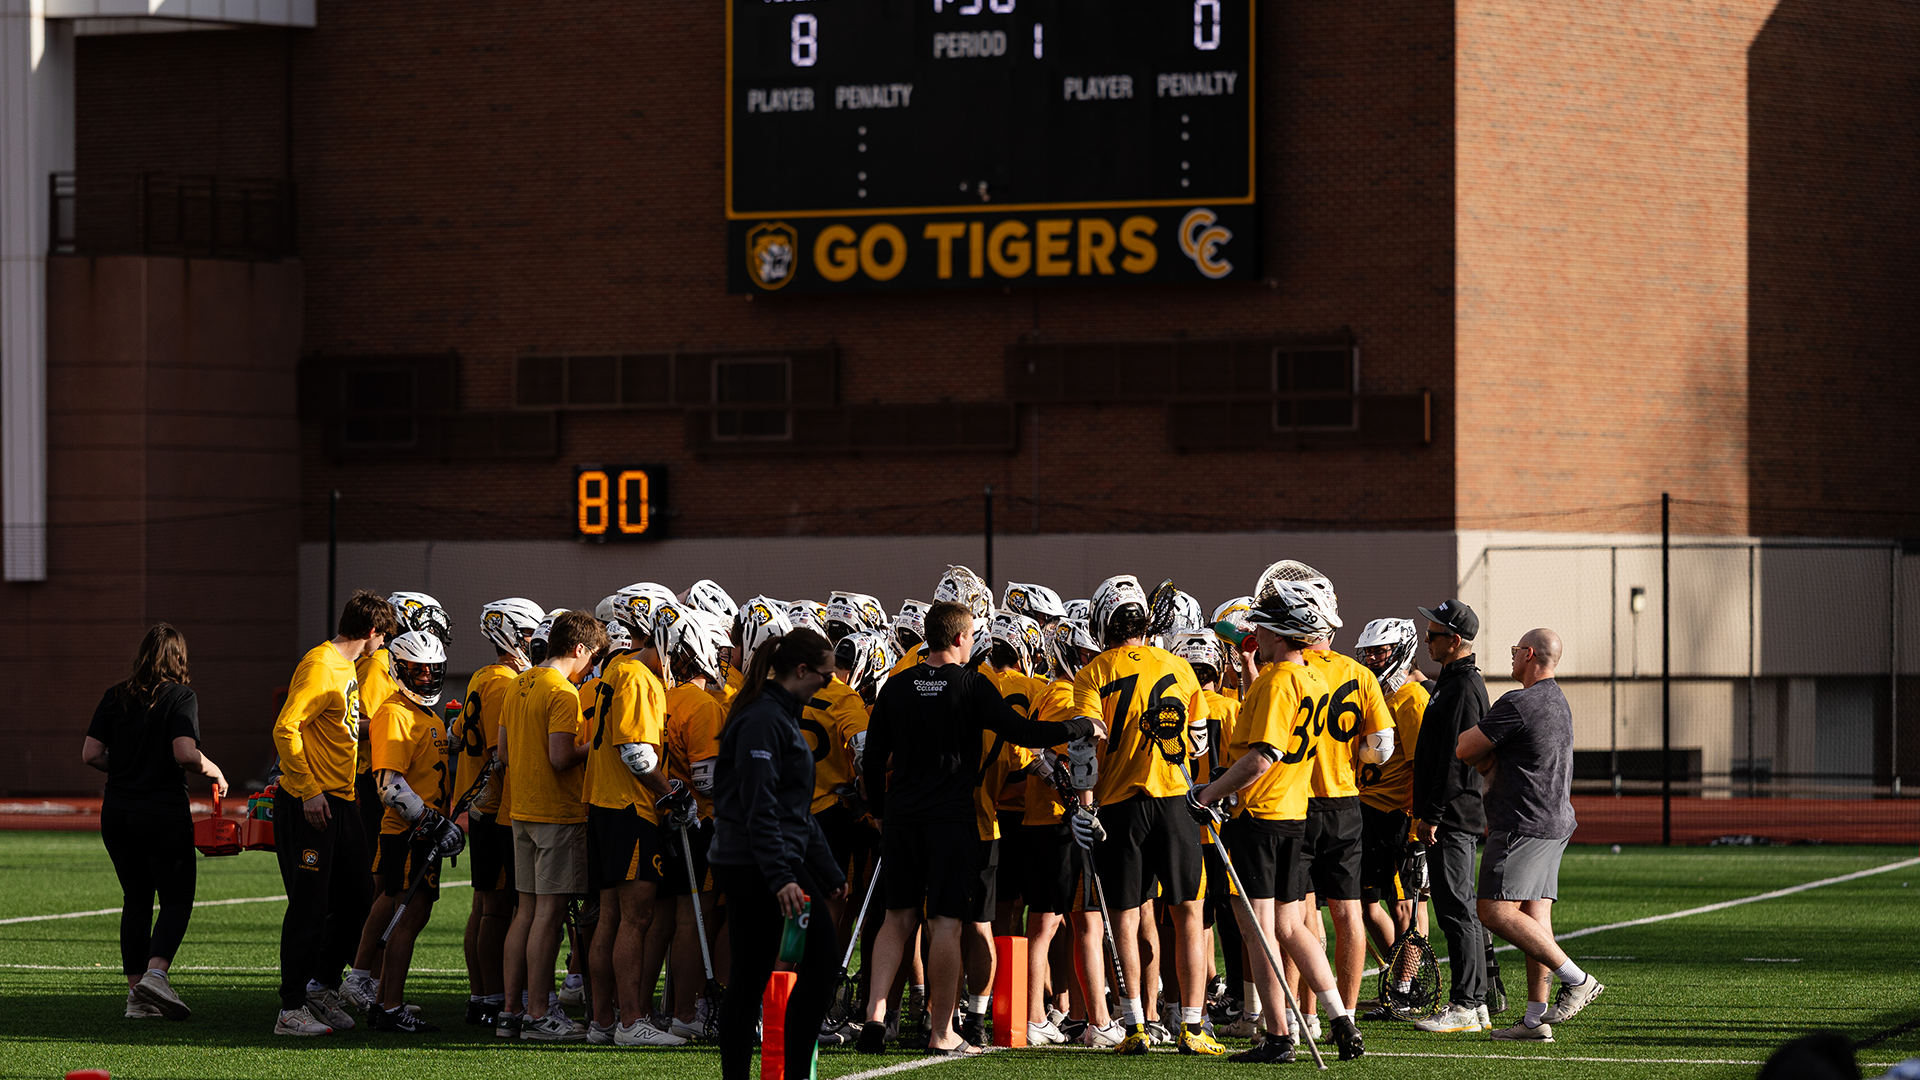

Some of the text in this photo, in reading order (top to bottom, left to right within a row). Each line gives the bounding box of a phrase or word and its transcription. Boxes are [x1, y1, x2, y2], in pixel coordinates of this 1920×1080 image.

[1193, 0, 1220, 50] 0
[791, 13, 818, 67] 8
[933, 30, 1007, 58] PERIOD
[1033, 22, 1043, 60] 1
[835, 83, 914, 110] PENALTY
[1063, 75, 1133, 100] PLAYER
[1157, 71, 1237, 97] PENALTY
[747, 87, 815, 113] PLAYER
[813, 215, 1159, 282] GO TIGERS
[578, 470, 649, 534] 80
[1075, 607, 1087, 619] 22
[1301, 610, 1319, 625] 39
